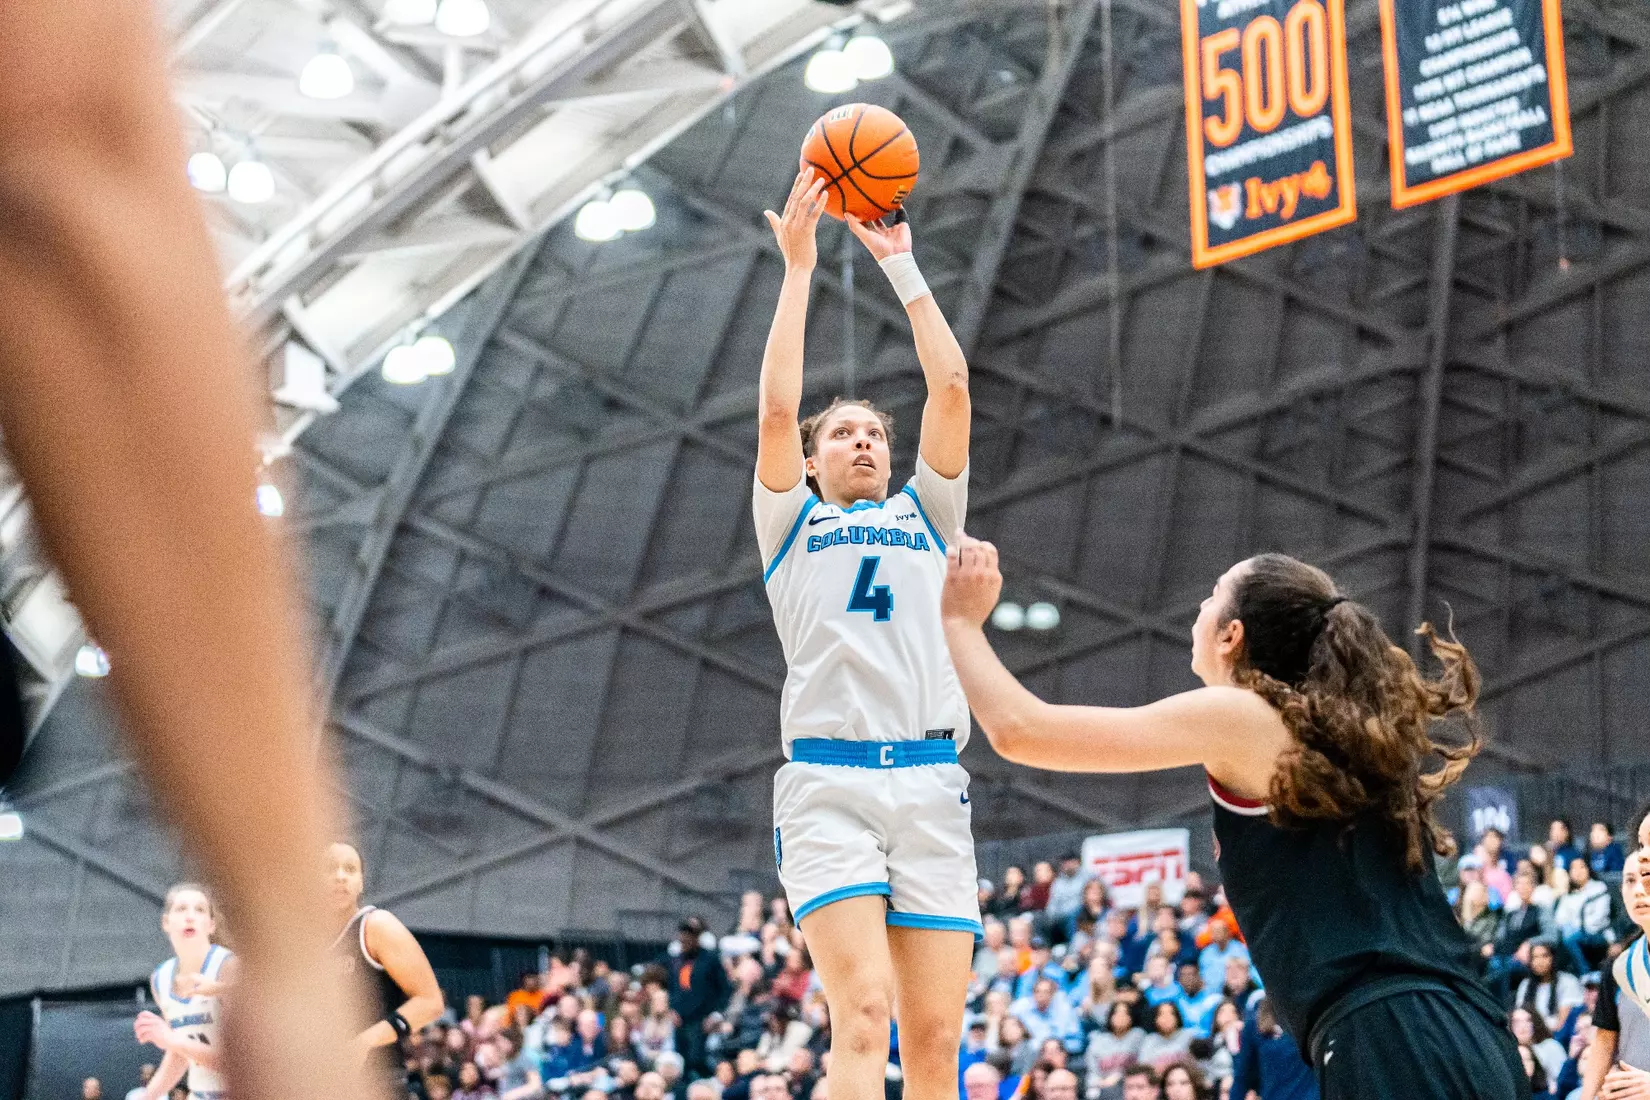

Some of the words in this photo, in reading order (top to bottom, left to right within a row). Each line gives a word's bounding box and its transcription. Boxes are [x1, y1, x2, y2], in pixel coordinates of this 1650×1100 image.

[1201, 0, 1329, 148] 500
[1245, 173, 1302, 219] Ivy
[807, 525, 930, 552] COLUMBIA
[846, 556, 894, 622] 4
[880, 745, 895, 766] C
